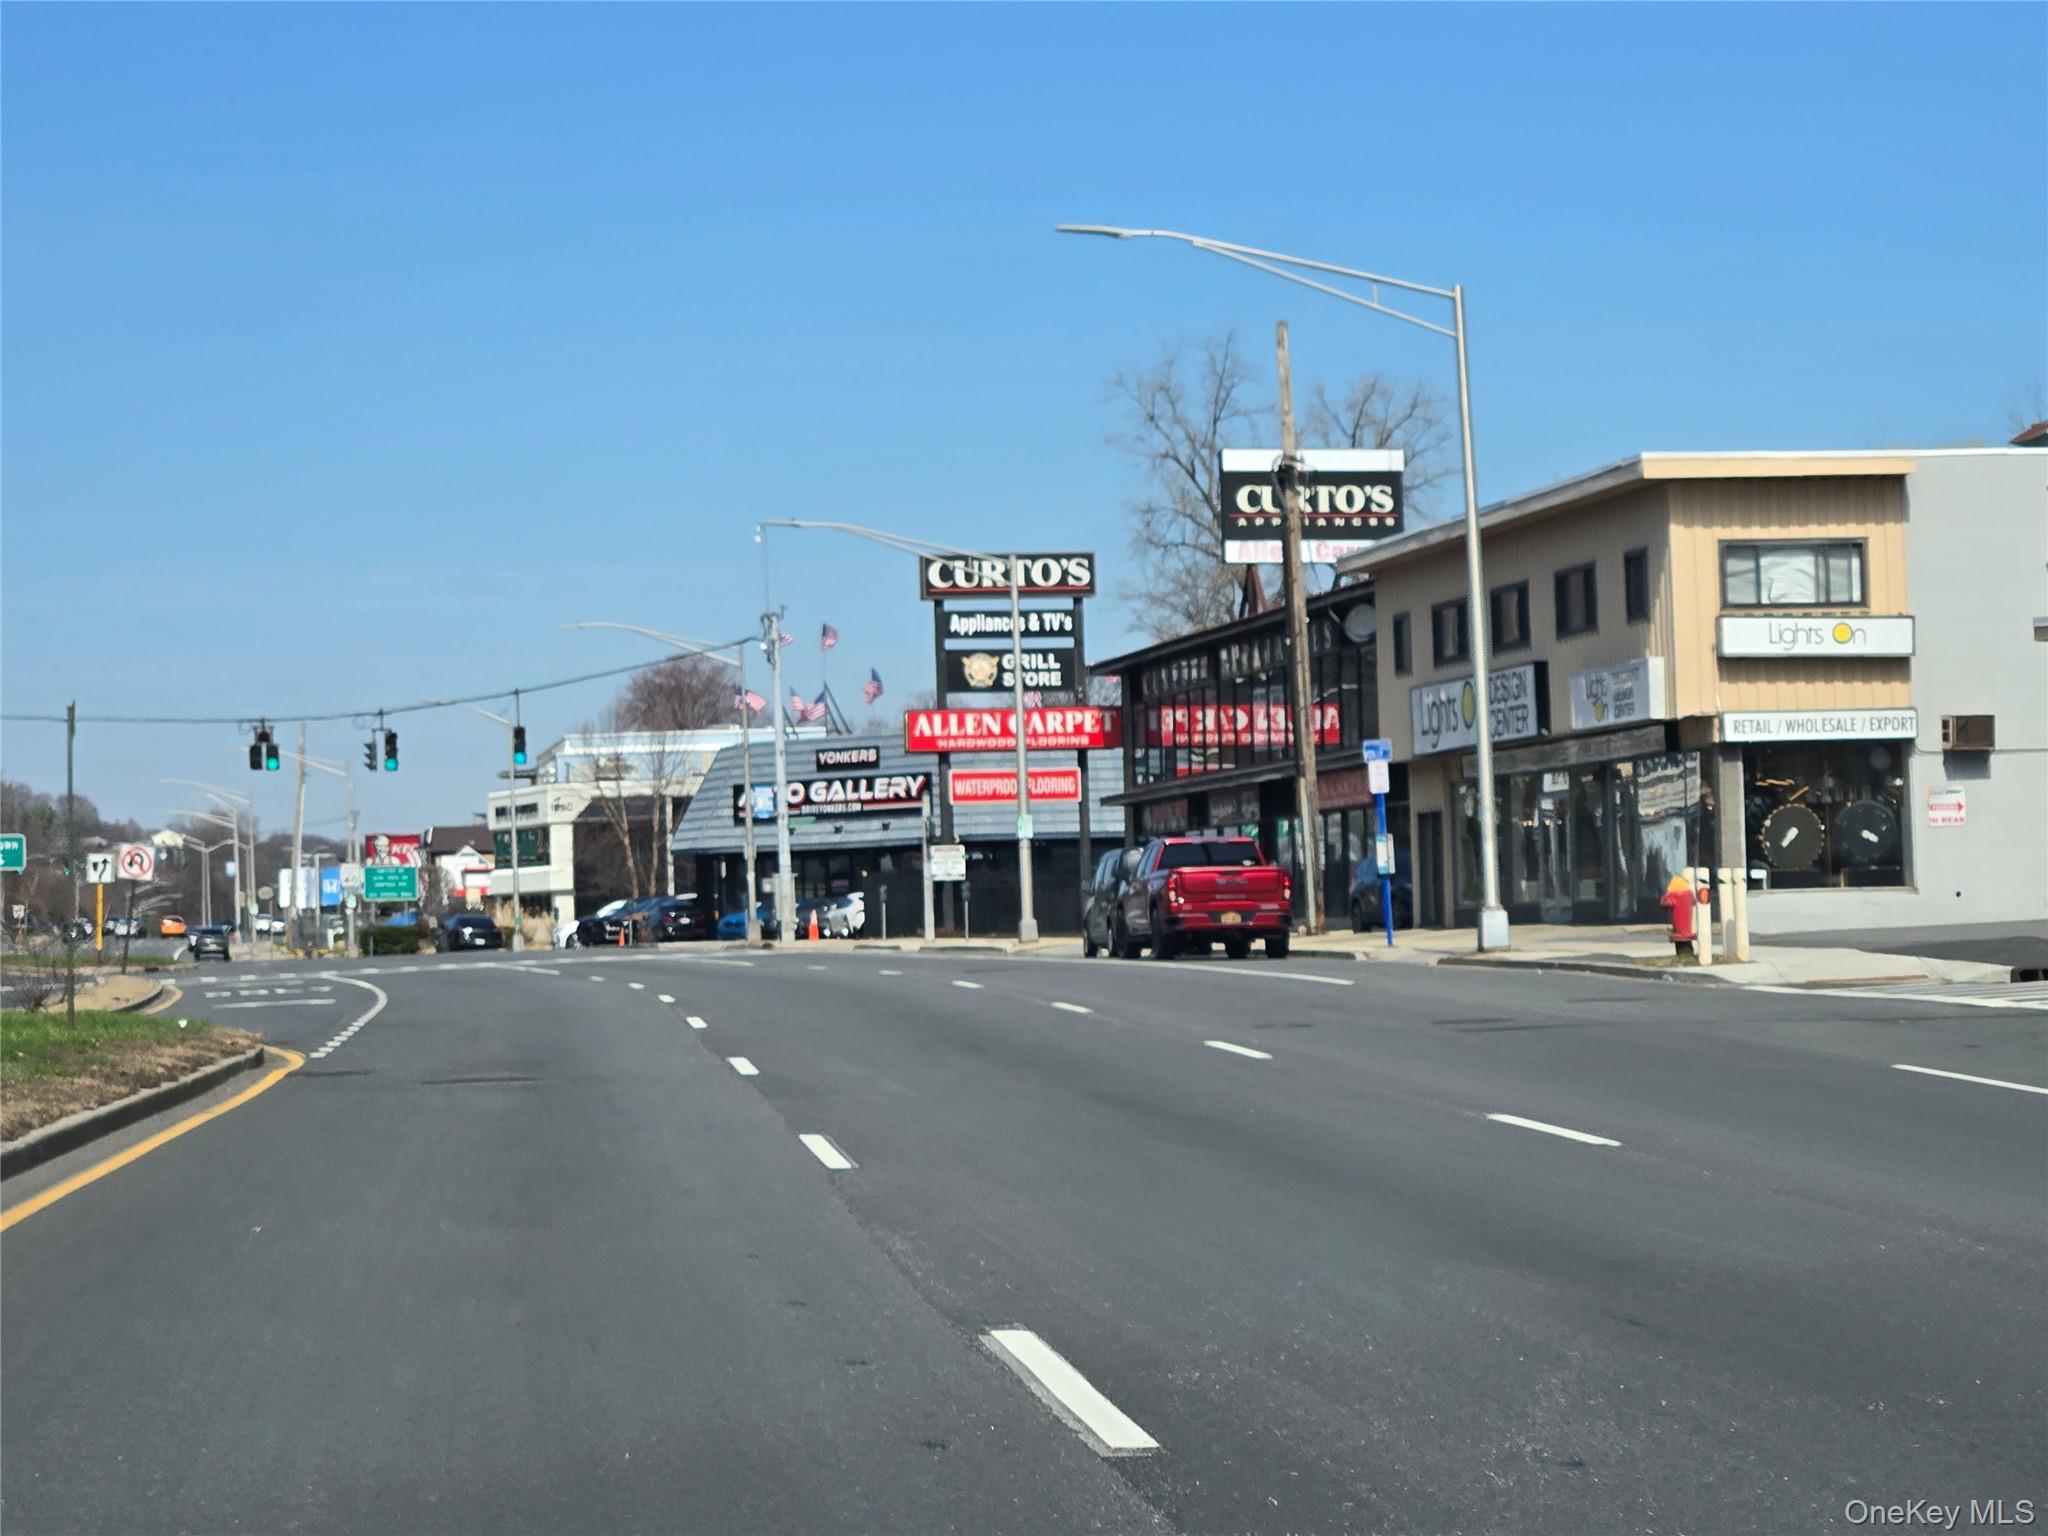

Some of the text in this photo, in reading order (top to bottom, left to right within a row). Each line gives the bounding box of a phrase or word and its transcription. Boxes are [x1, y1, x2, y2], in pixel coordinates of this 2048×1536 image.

[928, 558, 1091, 588] CURTO'S
[1028, 613, 1041, 632] &
[1042, 612, 1073, 631] TV's
[1768, 621, 1867, 651] Lights On
[1002, 653, 1061, 670] GRILL
[914, 712, 1004, 737] ALLEN
[1733, 719, 1774, 735] RETAIL
[1785, 717, 1857, 734] WHOLESALE
[1869, 716, 1915, 732] EXPORT
[818, 748, 877, 766] YONKERS
[808, 774, 926, 803] GALLERY
[955, 777, 1017, 797] WATERPROO
